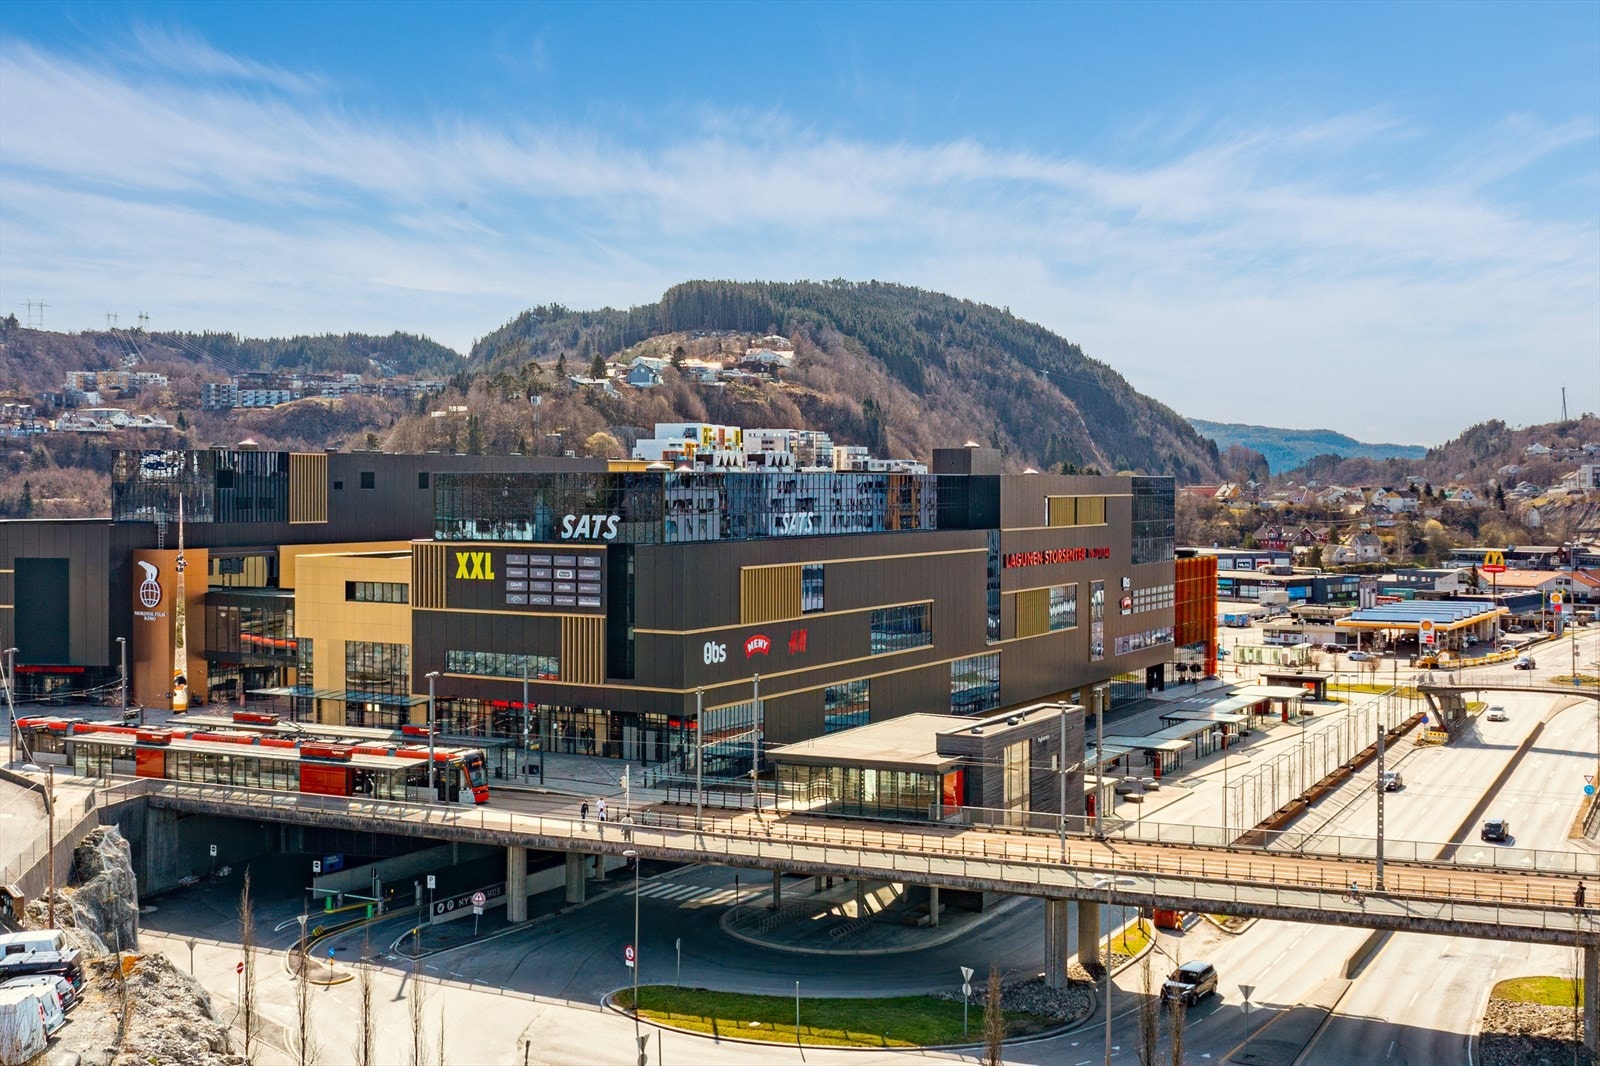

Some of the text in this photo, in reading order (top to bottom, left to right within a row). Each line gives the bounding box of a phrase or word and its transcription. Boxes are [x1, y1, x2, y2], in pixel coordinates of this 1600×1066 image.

[561, 514, 621, 540] SATS
[781, 512, 814, 535] SATS
[455, 552, 495, 580] XXL
[1004, 551, 1043, 568] LAGUNEN
[1044, 547, 1085, 565] STORSENTER
[703, 641, 727, 665] Obs
[747, 638, 769, 653] MENY
